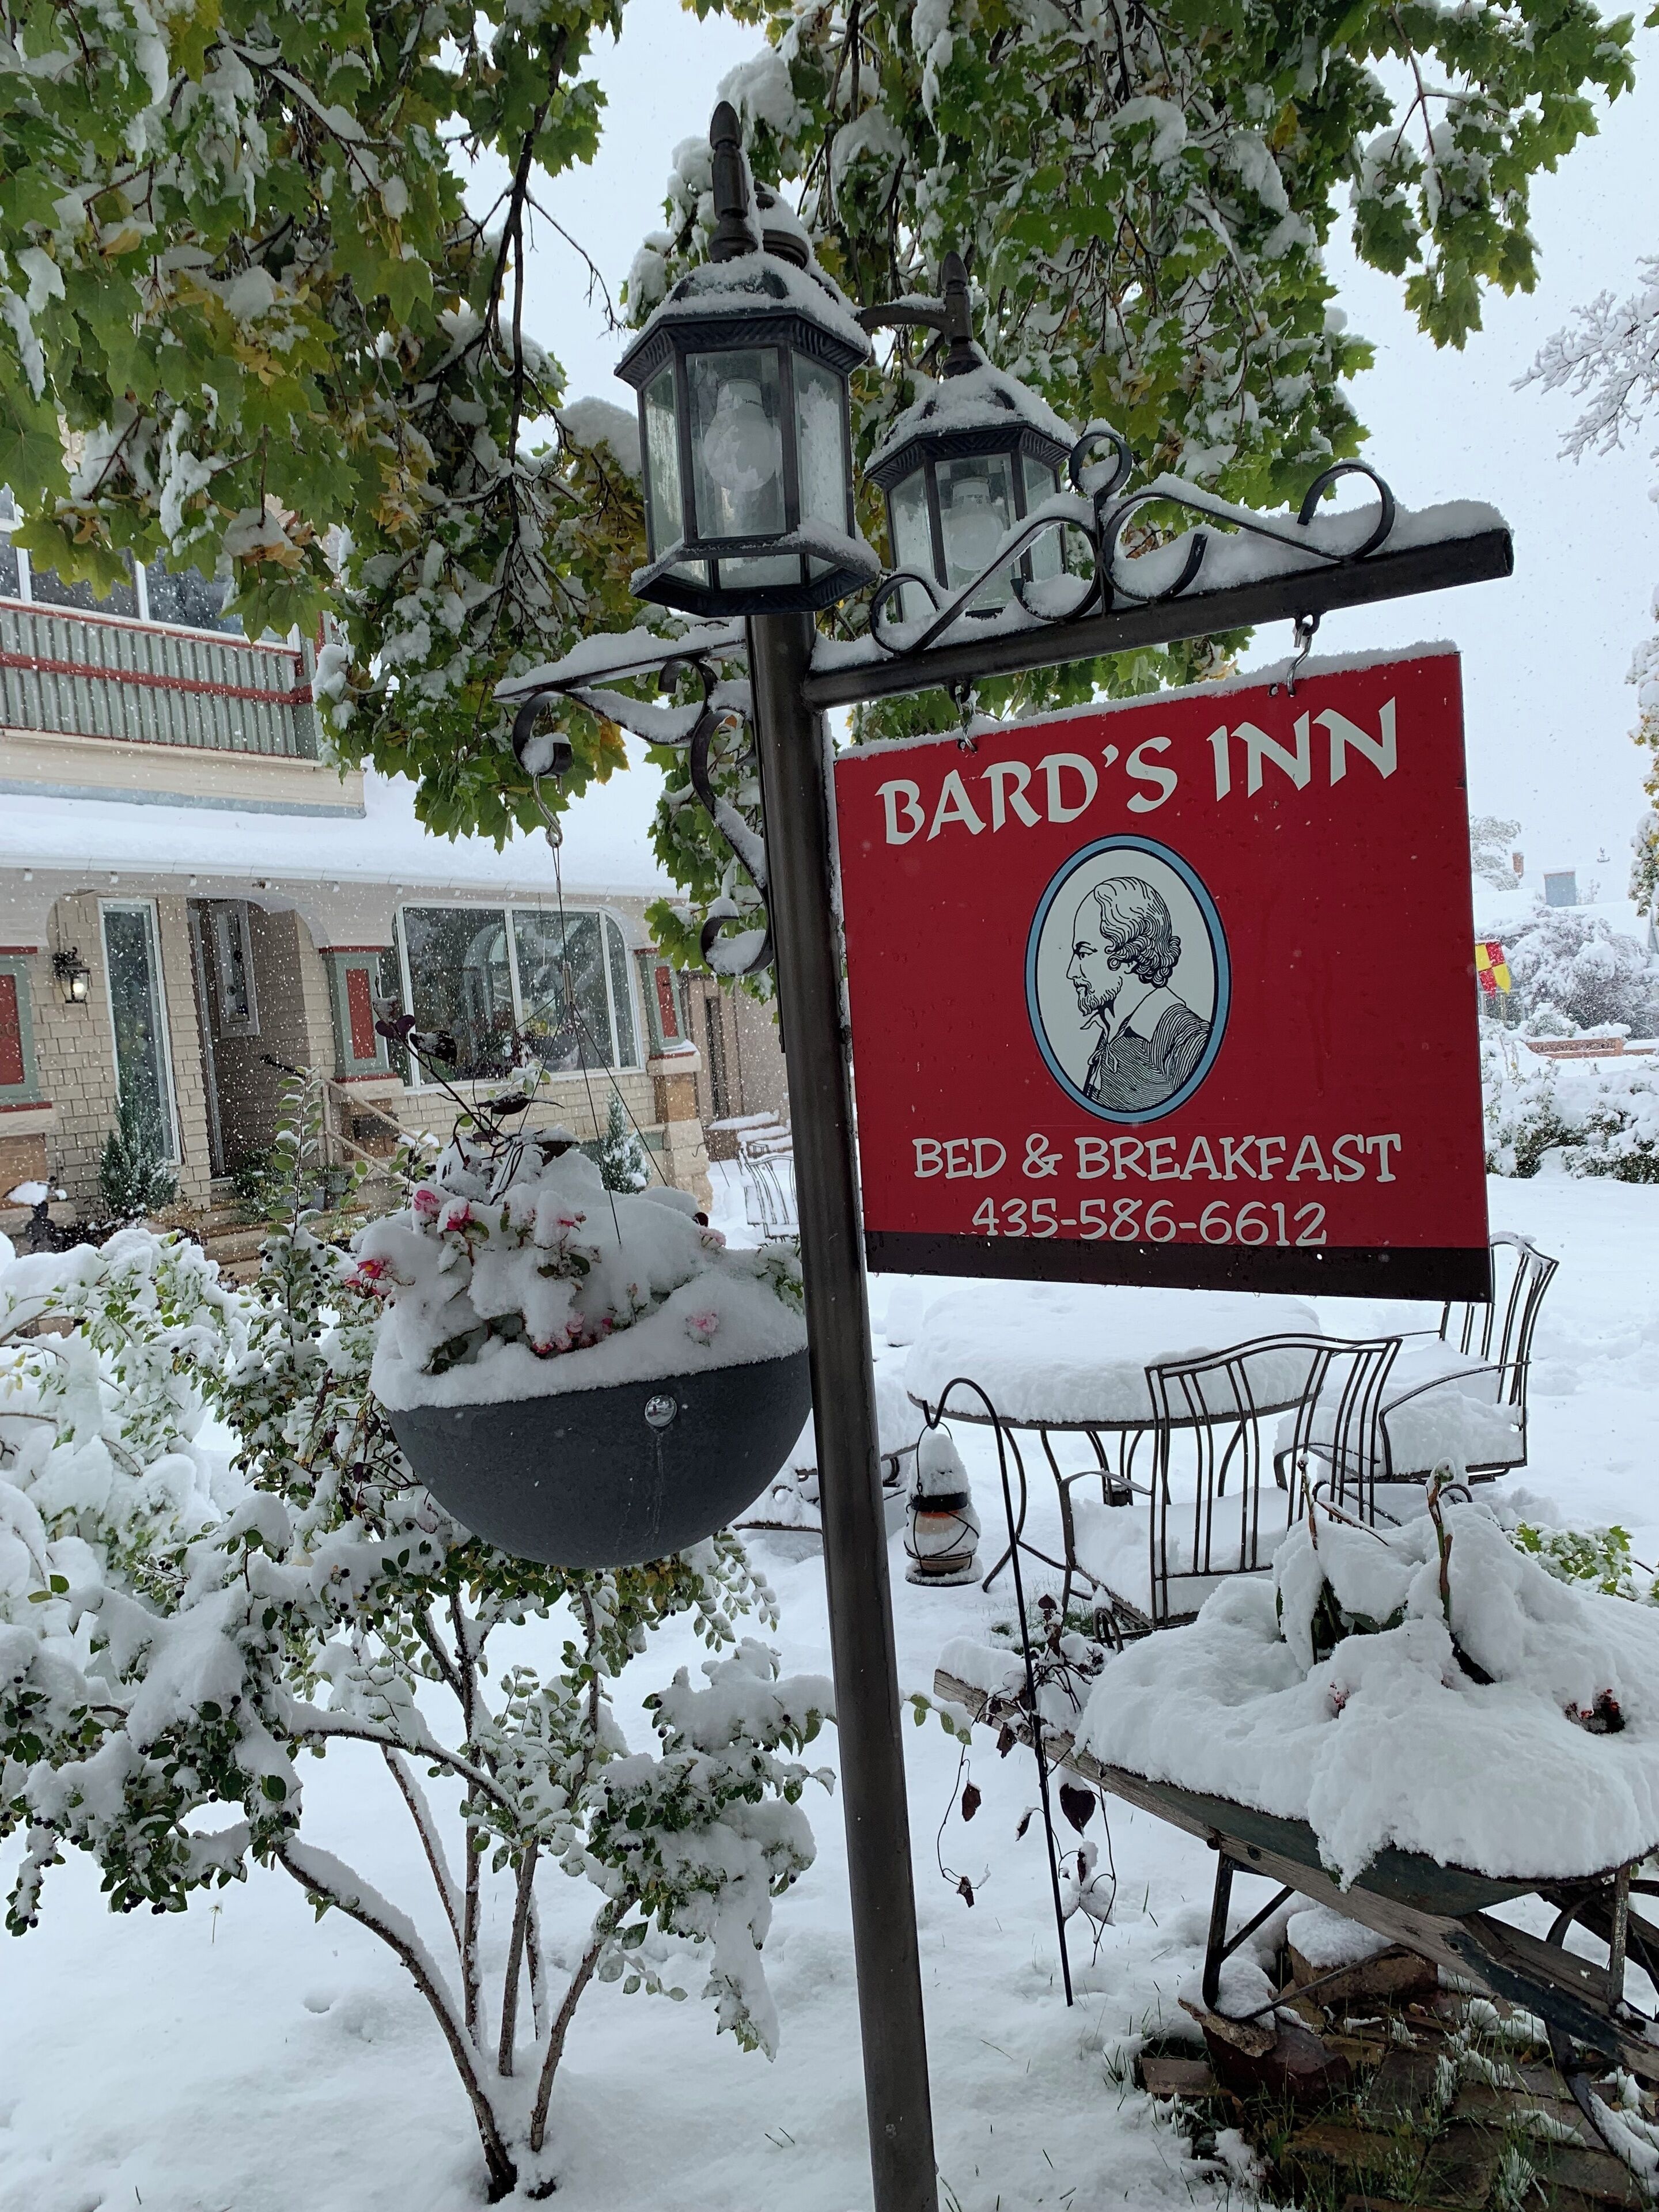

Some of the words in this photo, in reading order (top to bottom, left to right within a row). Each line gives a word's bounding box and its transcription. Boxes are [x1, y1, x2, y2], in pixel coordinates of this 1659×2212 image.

[874, 736, 1178, 845] BARD'S
[1206, 696, 1397, 802] INN
[912, 1137, 1007, 1179] BED
[1022, 1133, 1063, 1179] &
[1074, 1133, 1402, 1183] BREAKFAST
[972, 1197, 1327, 1247] 435-586-6612
